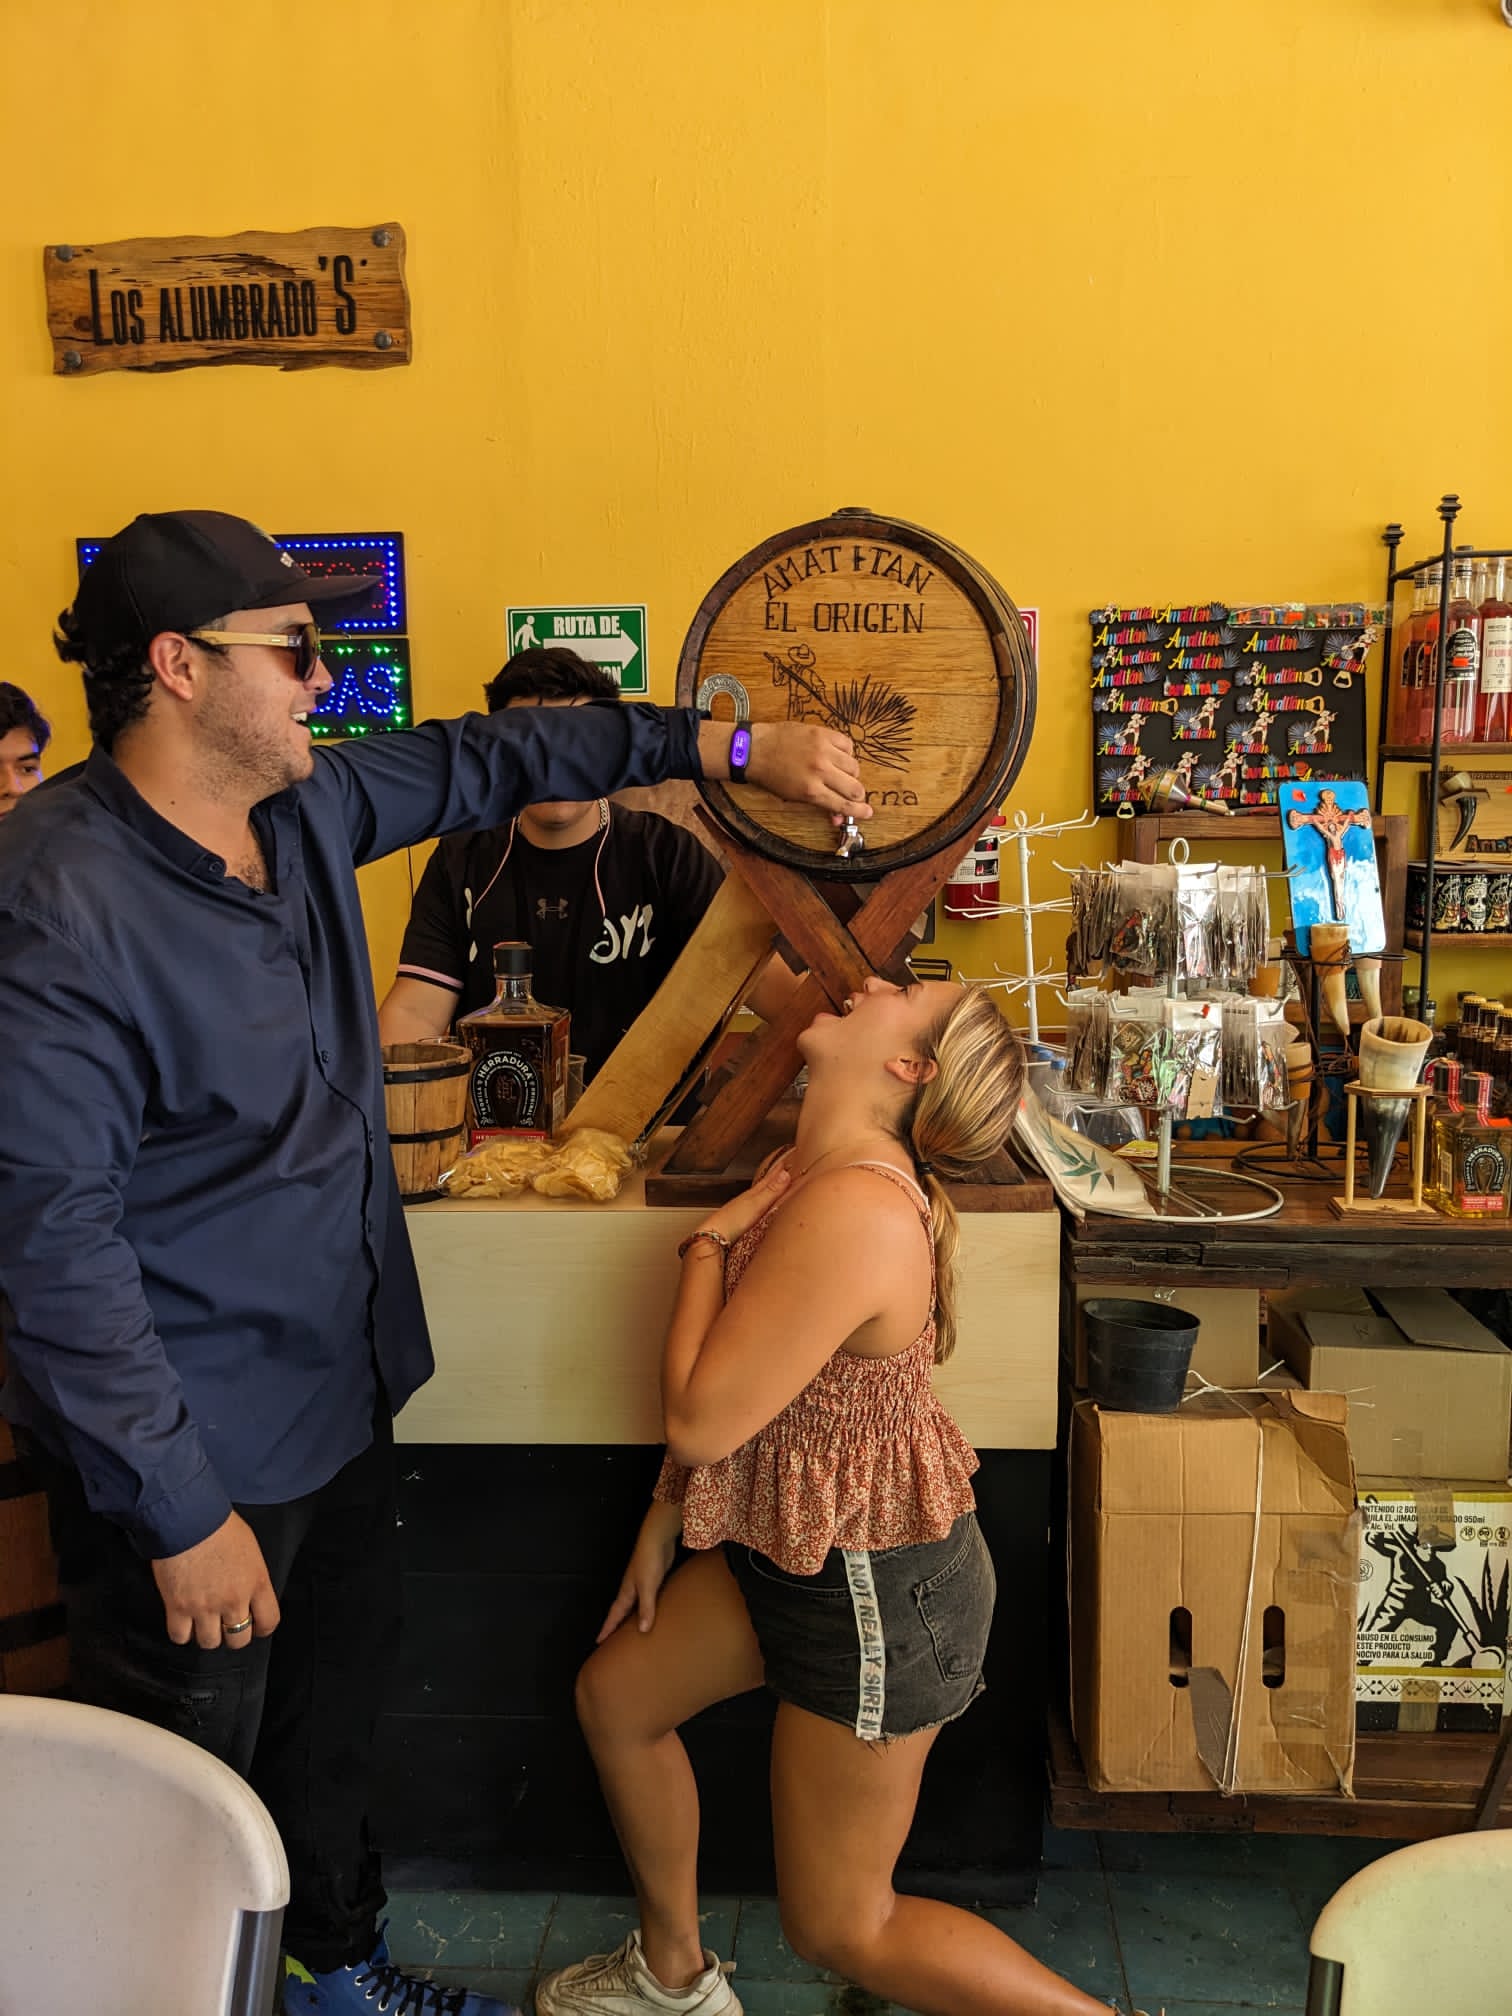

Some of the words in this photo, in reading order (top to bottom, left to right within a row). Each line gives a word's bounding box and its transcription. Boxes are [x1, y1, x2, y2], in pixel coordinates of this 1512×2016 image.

[553, 616, 597, 636] RUTA
[600, 615, 621, 635] DE
[765, 602, 797, 632] EL
[814, 602, 925, 633] ORIGEN
[477, 1055, 535, 1080] HERRADURA
[850, 1563, 873, 1599] NOT
[859, 1604, 883, 1669] REALLY
[1375, 1642, 1411, 1651] PRODUCTO
[1380, 1634, 1390, 1642] EN
[1391, 1634, 1399, 1642] EL
[1400, 1634, 1434, 1643] CONSUMO
[1382, 1651, 1400, 1659] PARA
[1410, 1652, 1433, 1660] SALUD
[863, 1672, 882, 1716] SURE
